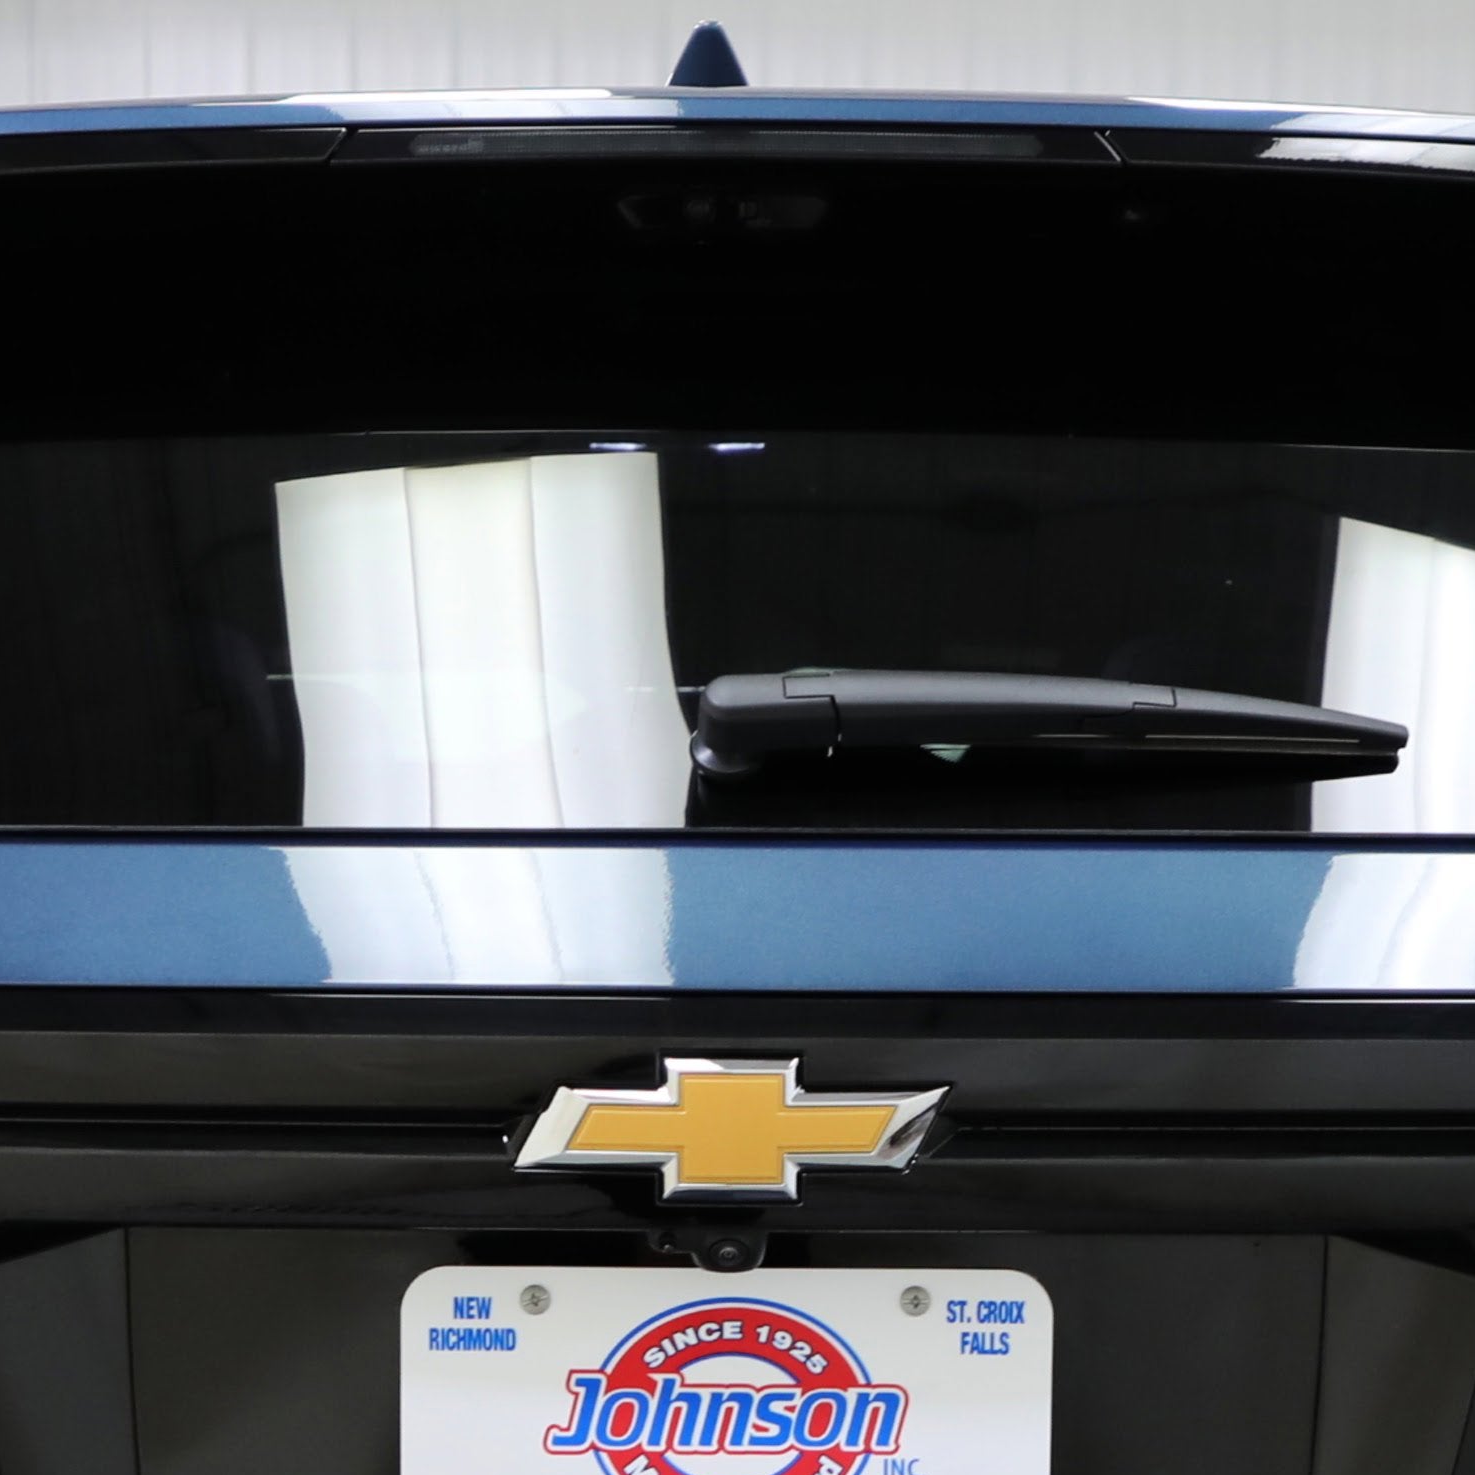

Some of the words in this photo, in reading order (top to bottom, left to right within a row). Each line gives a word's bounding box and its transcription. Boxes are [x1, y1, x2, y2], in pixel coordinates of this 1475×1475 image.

[453, 1297, 492, 1319] NEW
[946, 1300, 971, 1323] ST.
[977, 1300, 1025, 1324] CROIX
[429, 1328, 517, 1351] RICHMOND
[643, 1321, 743, 1368] SINCE
[756, 1325, 828, 1375] 1925
[960, 1332, 1010, 1355] FALLS
[548, 1375, 905, 1450] Johnson
